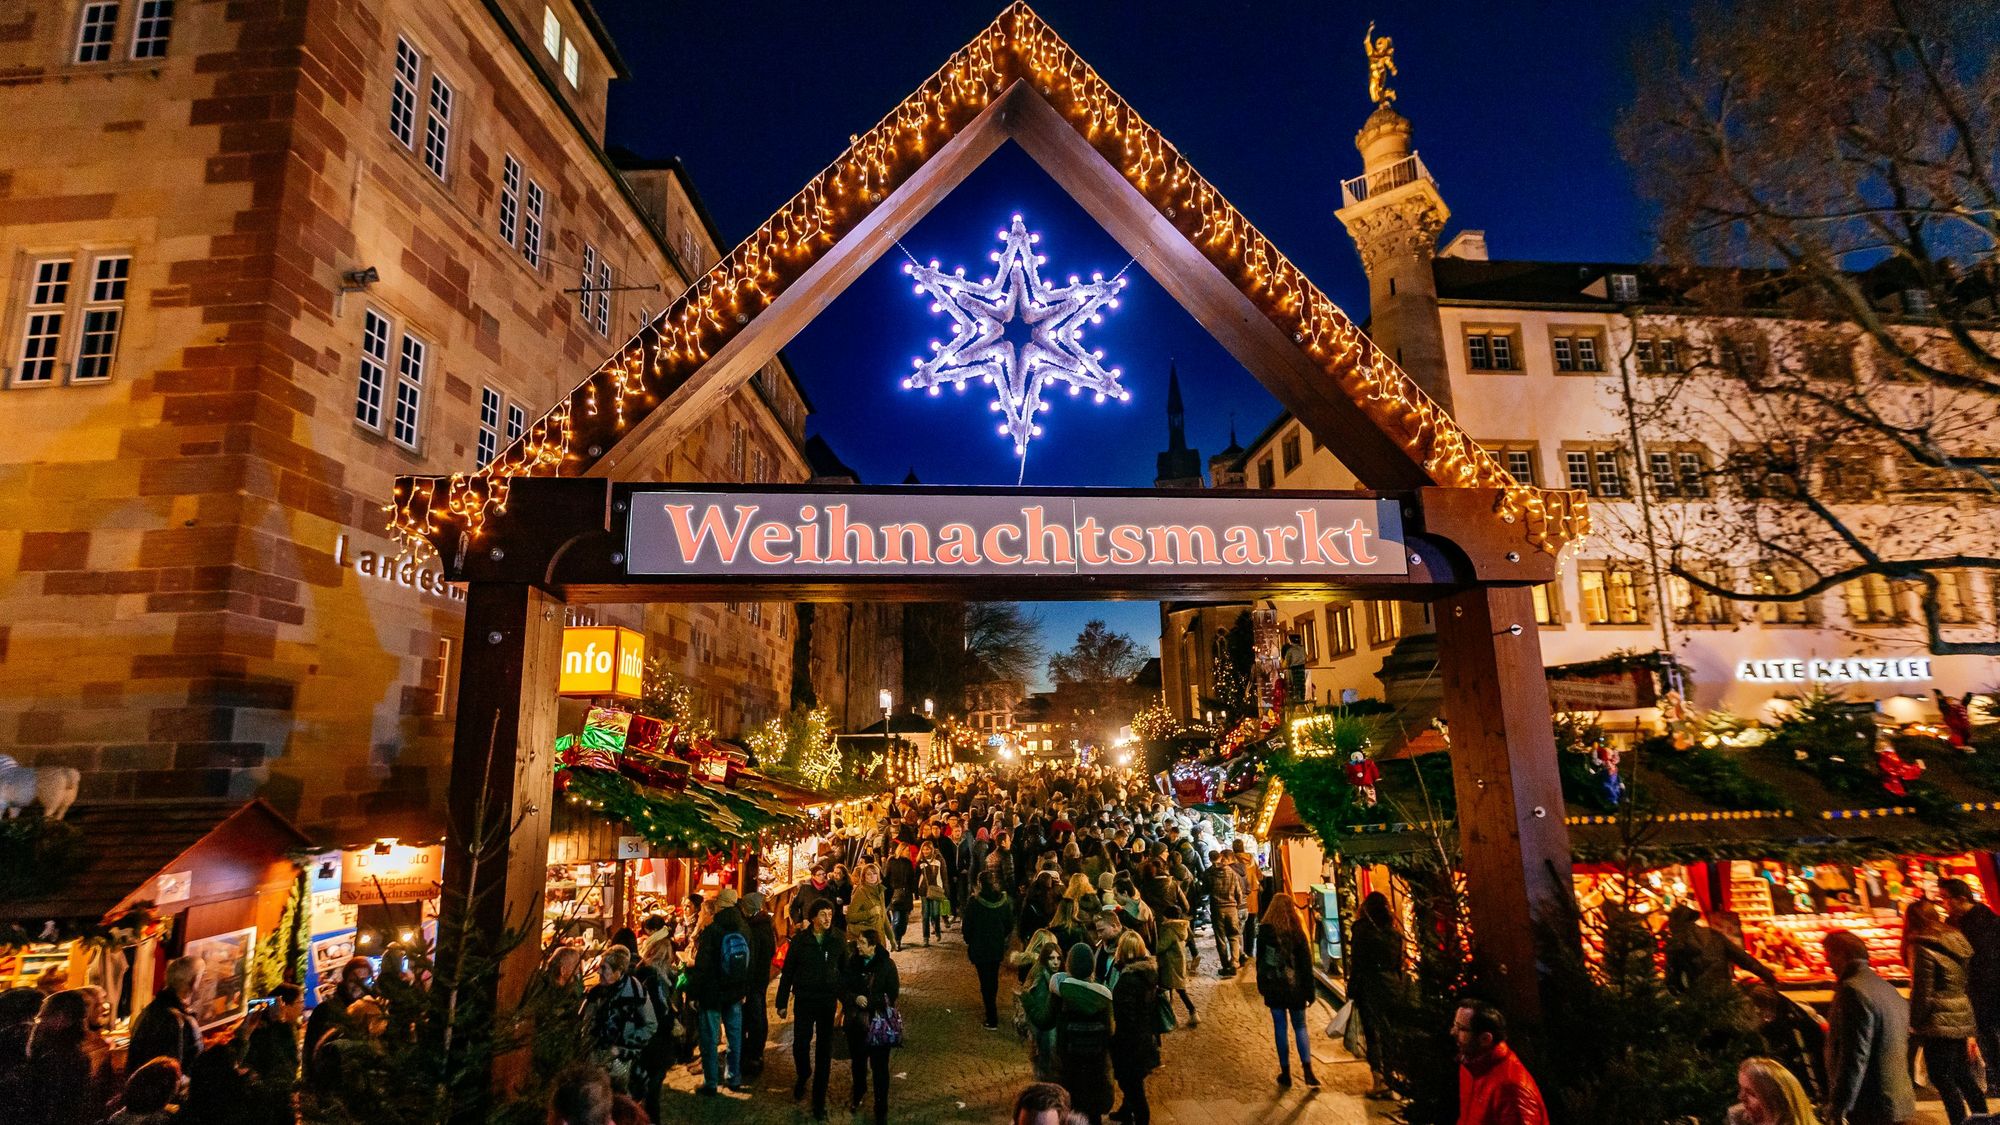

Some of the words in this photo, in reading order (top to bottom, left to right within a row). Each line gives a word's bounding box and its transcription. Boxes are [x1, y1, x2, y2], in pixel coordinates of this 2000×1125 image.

[665, 504, 1379, 565] Weihnachtsmarkt
[565, 642, 612, 674] nfo
[620, 647, 642, 678] Info
[1740, 660, 1804, 681] ALTE
[1812, 659, 1933, 681] KANZLEI
[627, 842, 640, 853] S1
